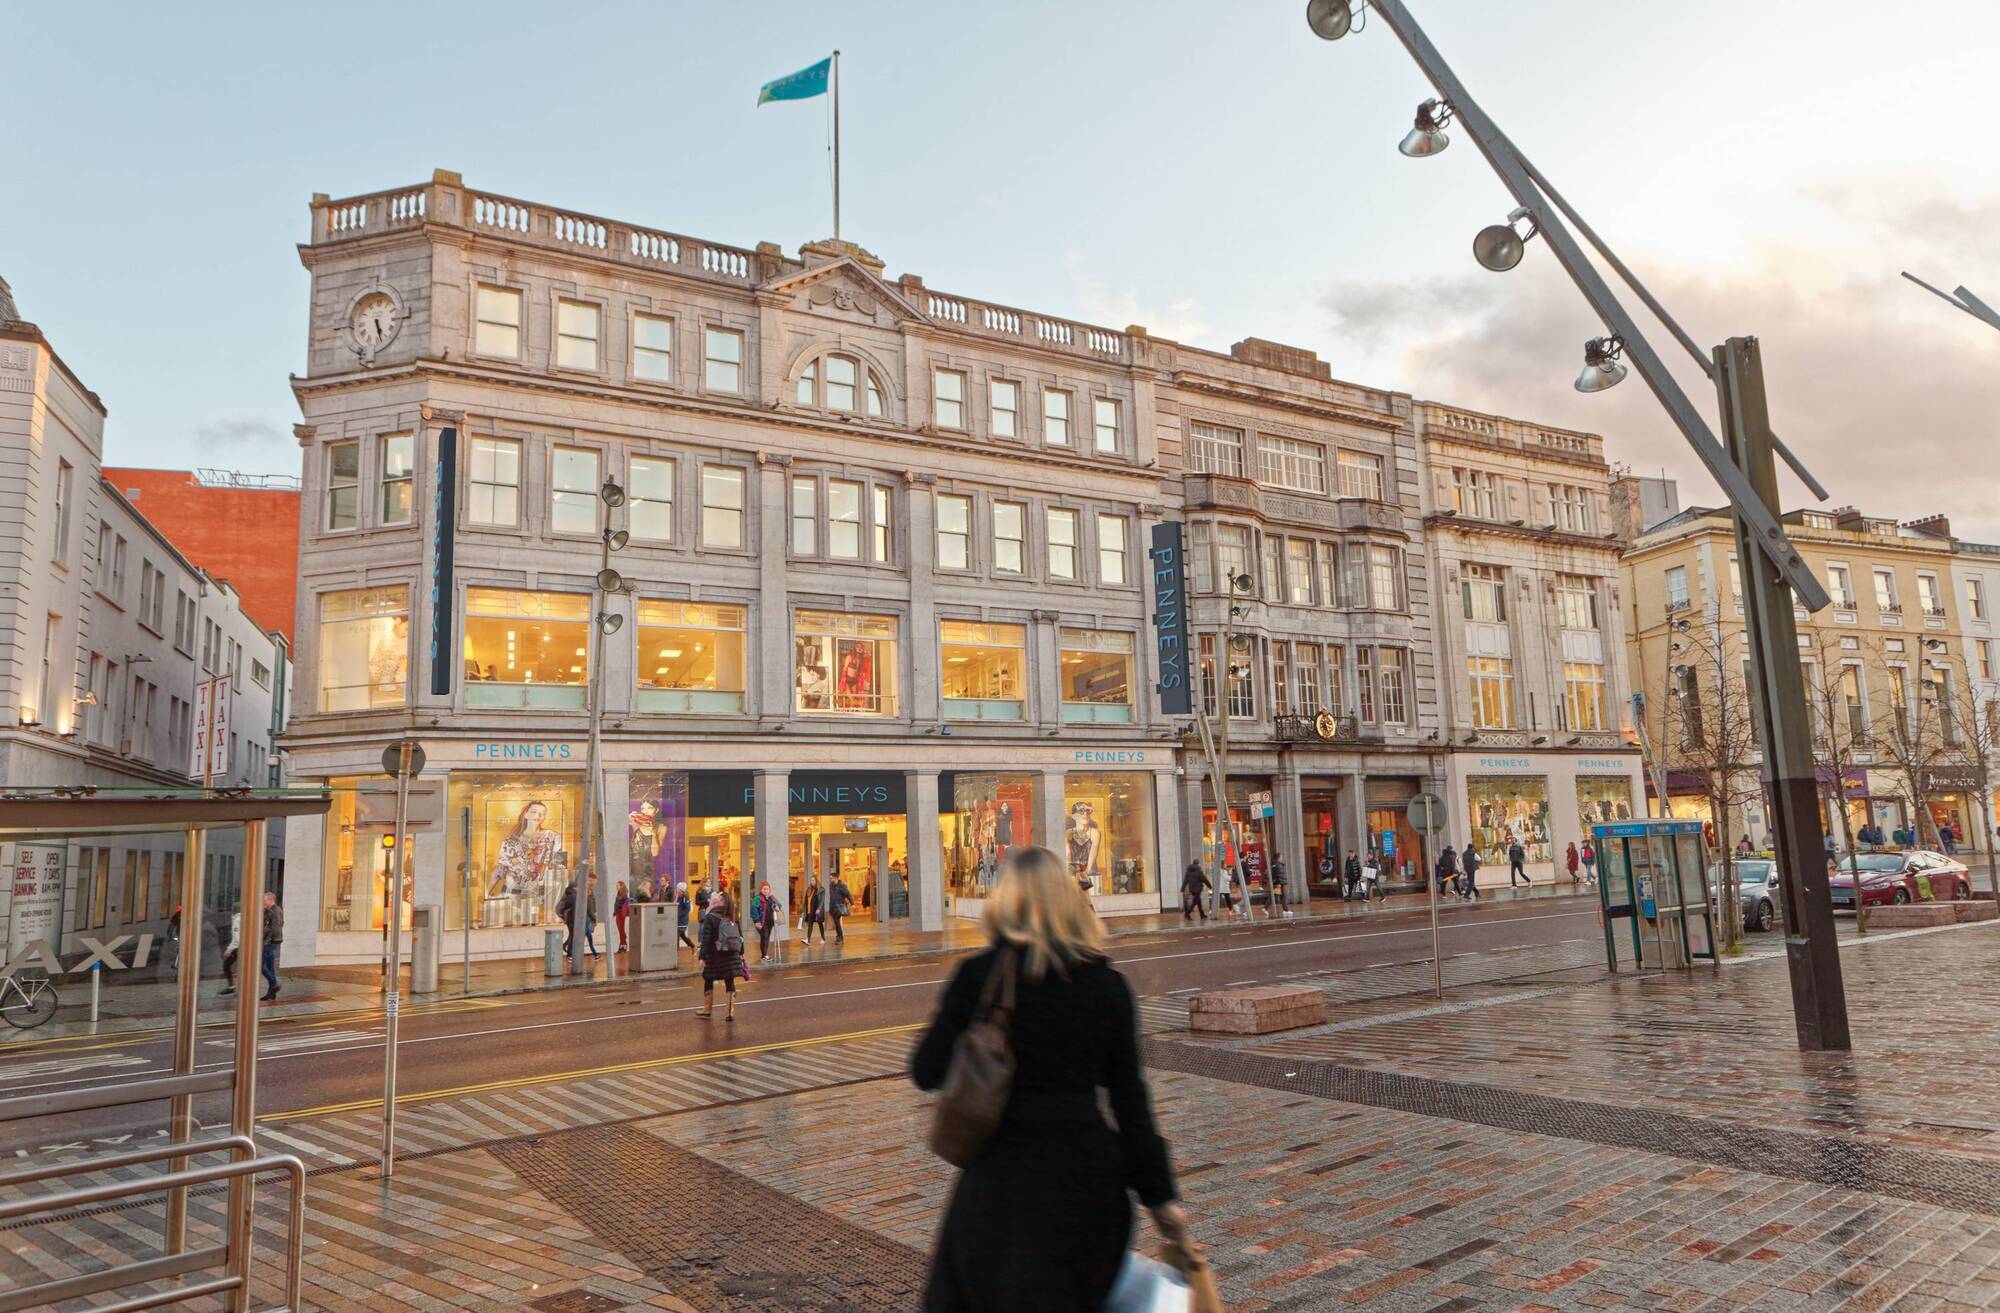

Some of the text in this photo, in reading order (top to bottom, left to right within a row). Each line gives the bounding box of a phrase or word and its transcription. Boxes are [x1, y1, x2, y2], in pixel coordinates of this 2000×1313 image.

[1154, 547, 1181, 689] PENNEYS
[196, 687, 207, 772] TAXI
[217, 682, 227, 770] TAXI
[476, 743, 571, 758] PENNEYS
[1075, 751, 1145, 762] PENNEYS
[1480, 758, 1531, 768] PENNEYS
[1577, 759, 1624, 768] PENNEYS
[744, 786, 888, 804] PNNEYS
[21, 851, 33, 864] SELF
[47, 852, 59, 865] OPEN
[16, 867, 36, 880] SERVICE
[14, 883, 37, 897] BANKING
